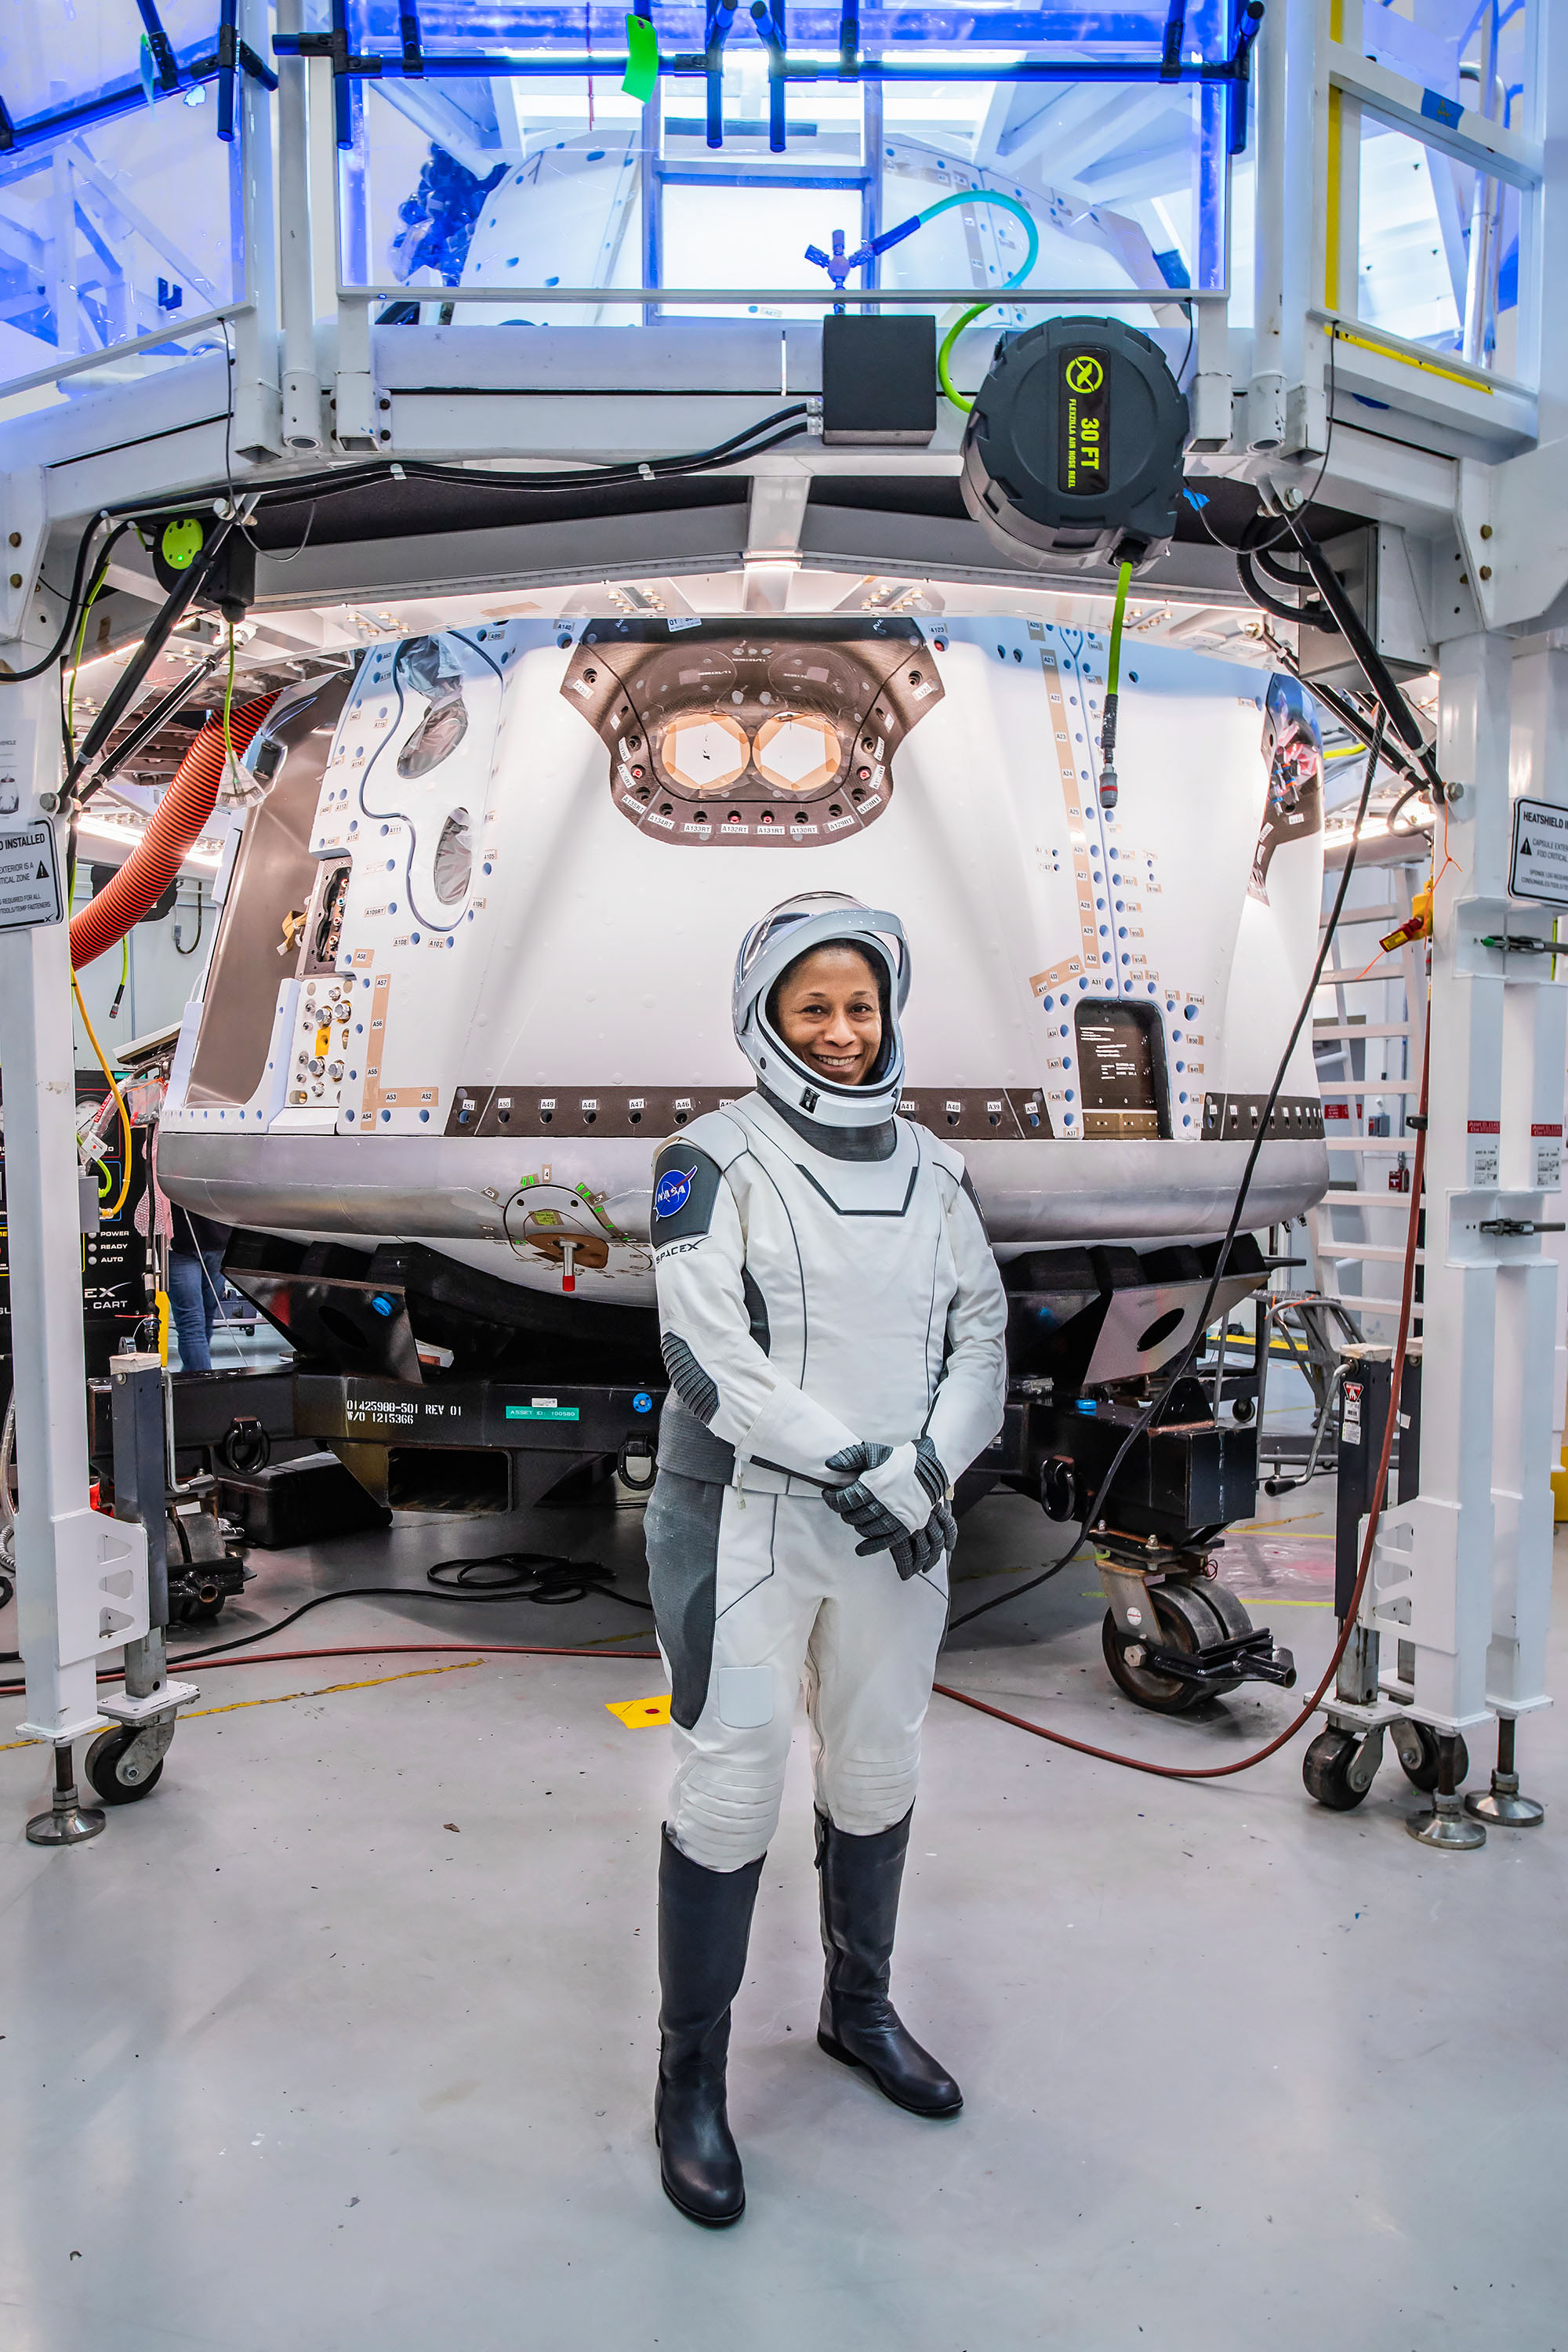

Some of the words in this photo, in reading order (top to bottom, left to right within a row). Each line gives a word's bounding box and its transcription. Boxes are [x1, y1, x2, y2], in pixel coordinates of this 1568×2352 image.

[1081, 418, 1099, 441] 30
[1081, 447, 1099, 470] FT
[650, 815, 673, 827] A134RT
[829, 817, 852, 830] A129RT
[1523, 811, 1563, 829] HEATSHIELD
[5, 833, 45, 849] INSTALLED
[27, 901, 51, 910] FASTENERS
[95, 1094, 112, 1122] RETURN
[659, 1185, 686, 1203] NASA
[655, 1235, 712, 1265] SPACEX
[93, 1300, 128, 1309] CART
[347, 1399, 418, 1414] 01425988-501
[426, 1404, 445, 1415] REV
[450, 1405, 461, 1416] 01
[347, 1410, 365, 1421] W/O
[372, 1413, 414, 1425] 1215366
